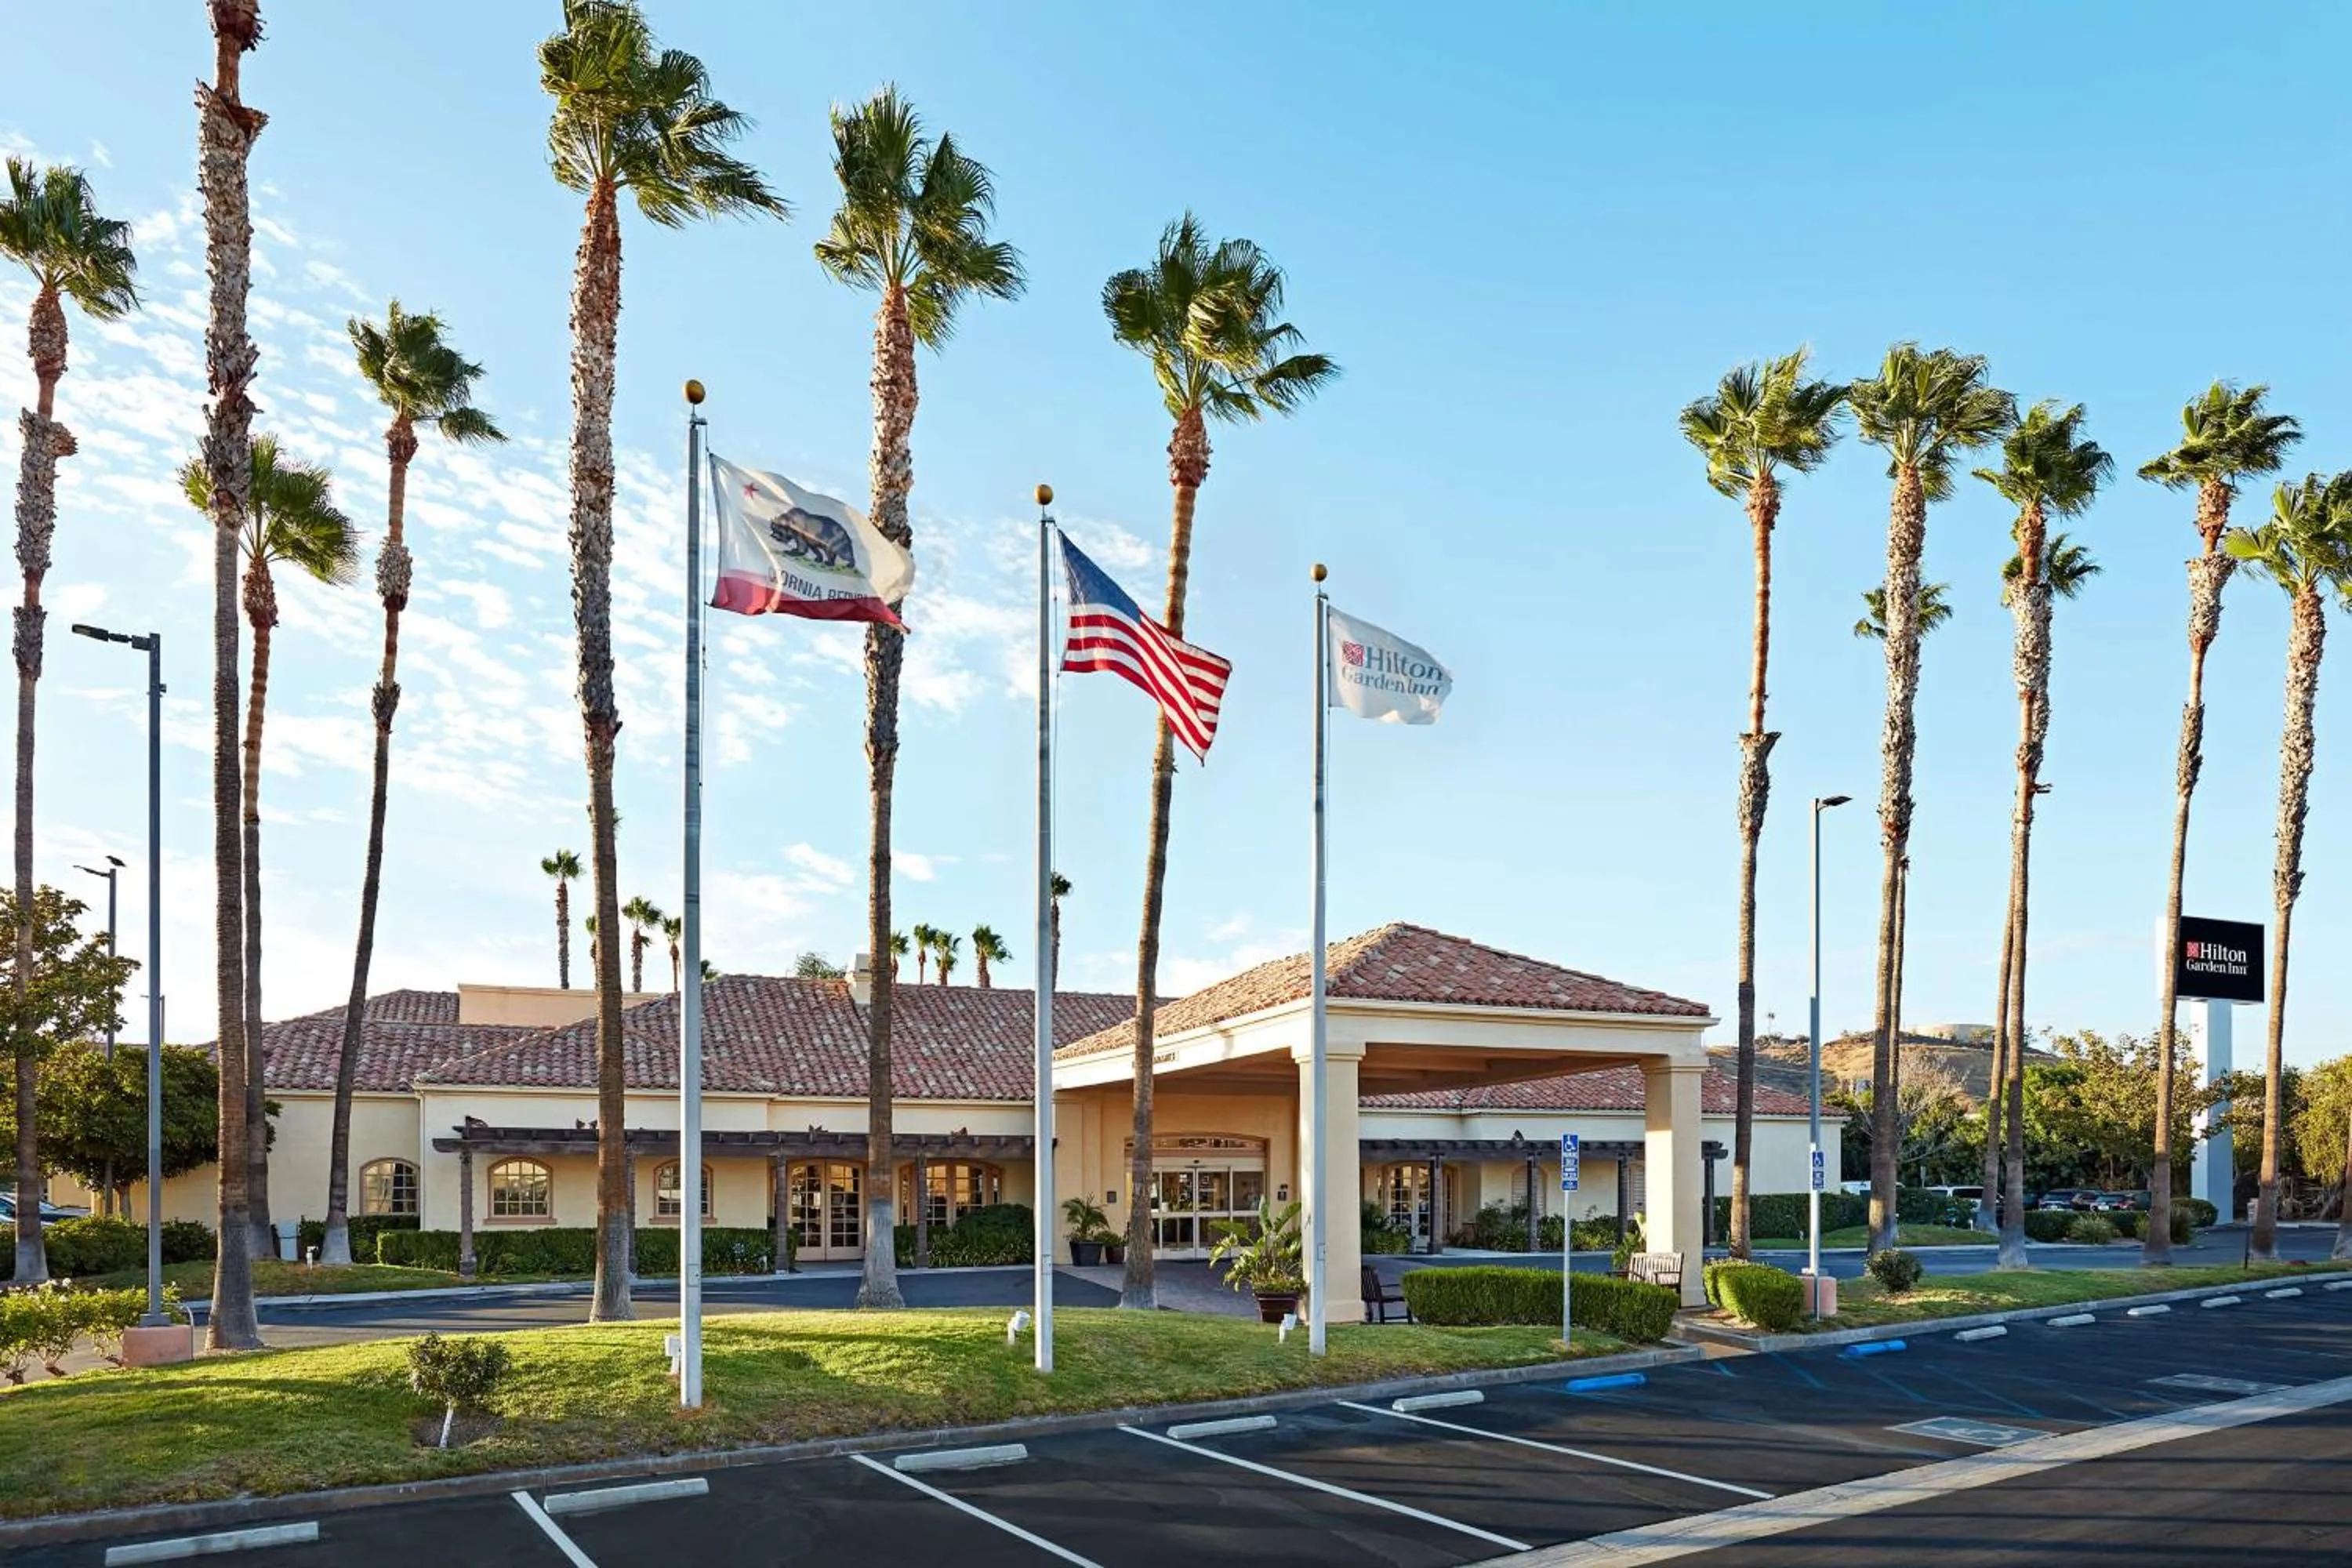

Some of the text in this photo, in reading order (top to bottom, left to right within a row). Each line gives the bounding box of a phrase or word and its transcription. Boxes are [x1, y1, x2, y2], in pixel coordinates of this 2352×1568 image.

[1365, 645, 1443, 681] Hilton
[1341, 666, 1439, 695] Garden Inn
[2200, 942, 2247, 963] Hilton
[2186, 958, 2248, 975] Garden Inn
